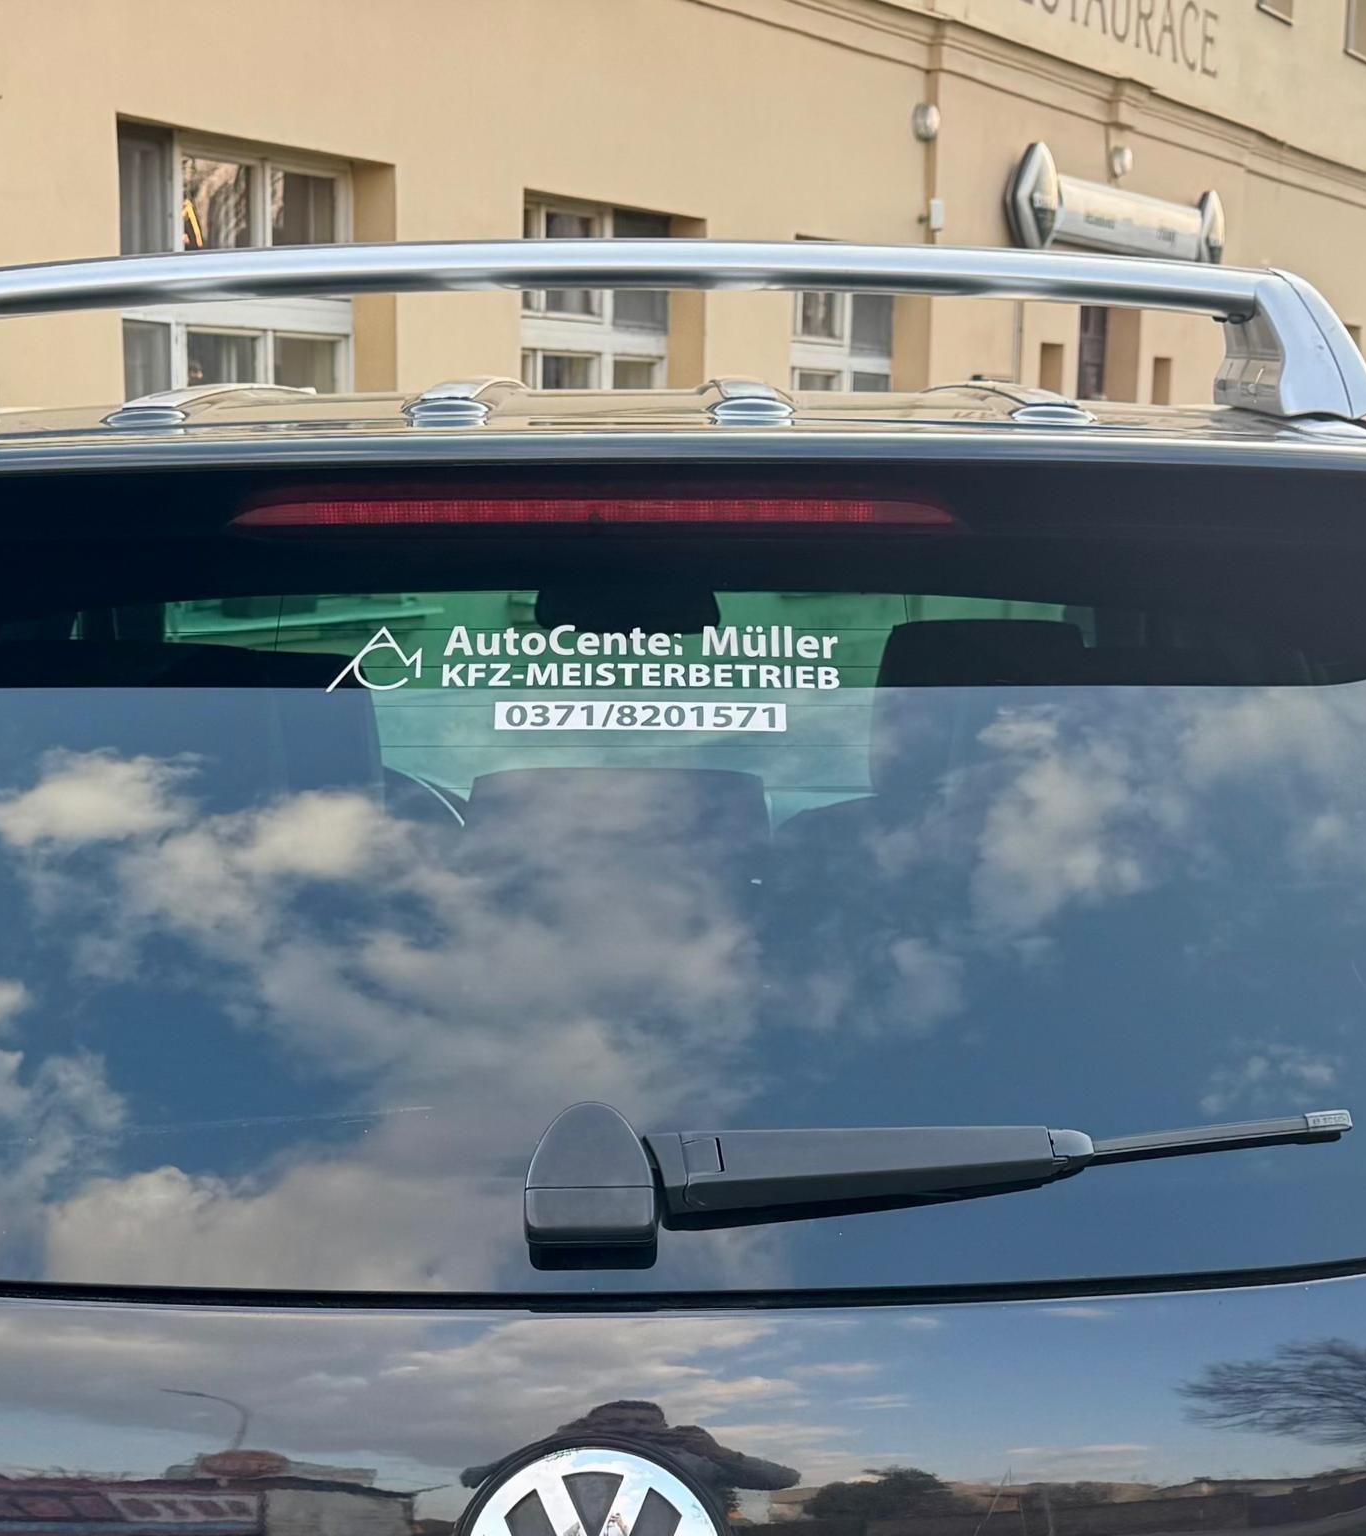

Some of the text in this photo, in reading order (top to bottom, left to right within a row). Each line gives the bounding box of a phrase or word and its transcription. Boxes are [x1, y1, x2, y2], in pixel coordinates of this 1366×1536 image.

[701, 625, 839, 659] Müller
[441, 663, 841, 690] KFZ-MEISTERBETRIEB
[505, 704, 777, 729] 0371/8201571
